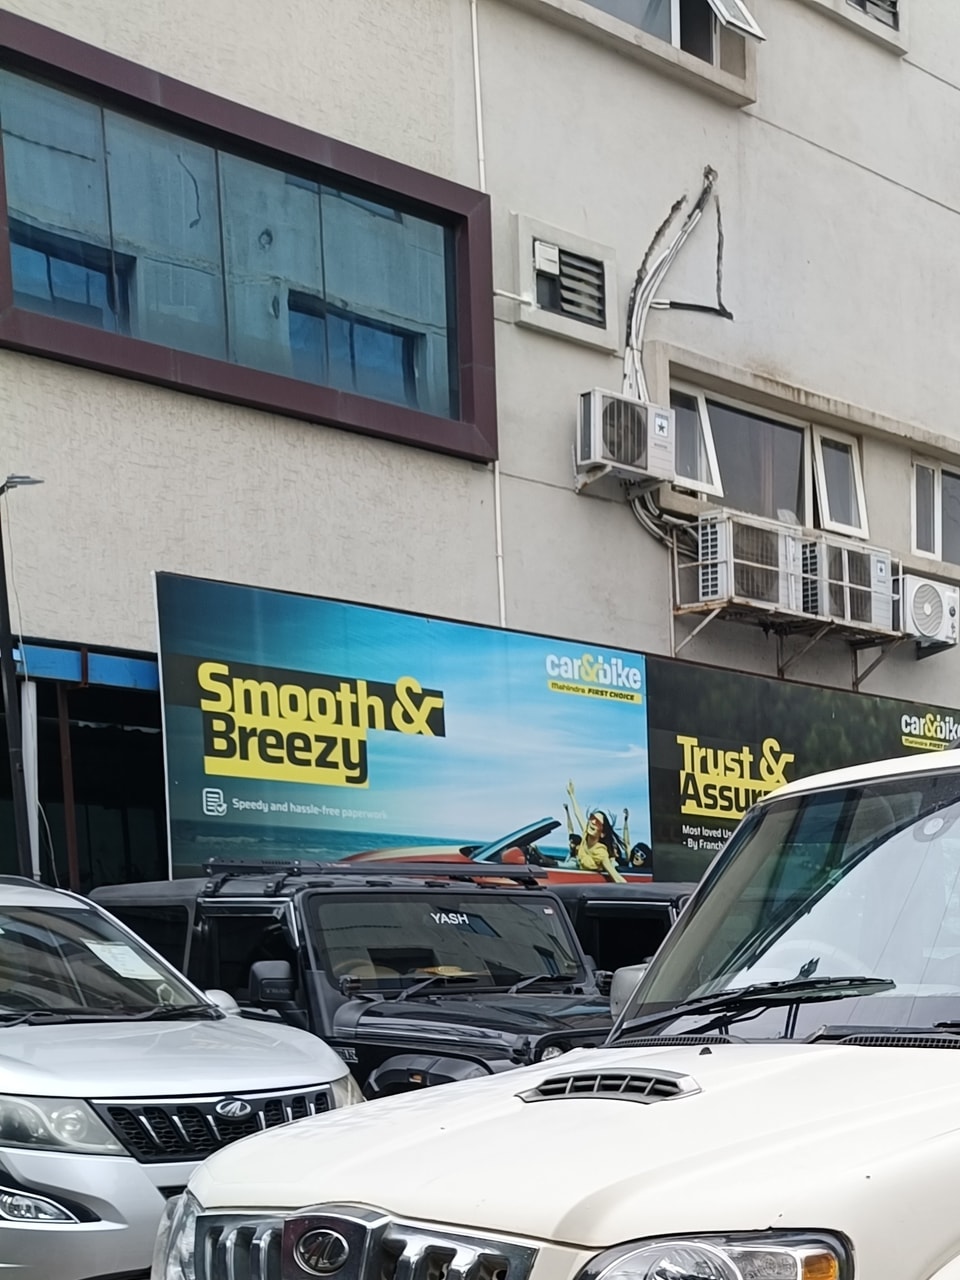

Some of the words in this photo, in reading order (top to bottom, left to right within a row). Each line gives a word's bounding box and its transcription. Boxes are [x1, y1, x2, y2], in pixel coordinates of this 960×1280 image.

[545, 653, 641, 689] car&bike
[198, 662, 384, 731] Smooth
[391, 675, 444, 736] &
[551, 682, 586, 694] Mahindra
[587, 687, 608, 697] FIRST
[609, 691, 635, 701] CHOICE
[202, 710, 368, 785] Breezy
[677, 735, 753, 780] Trust
[760, 738, 795, 784] &
[231, 798, 268, 813] Speedy
[270, 801, 288, 812] and
[290, 802, 340, 817] hassle-free
[682, 824, 700, 836] Most
[702, 826, 721, 838] loved
[688, 838, 697, 850] By
[430, 913, 469, 924] YASH
